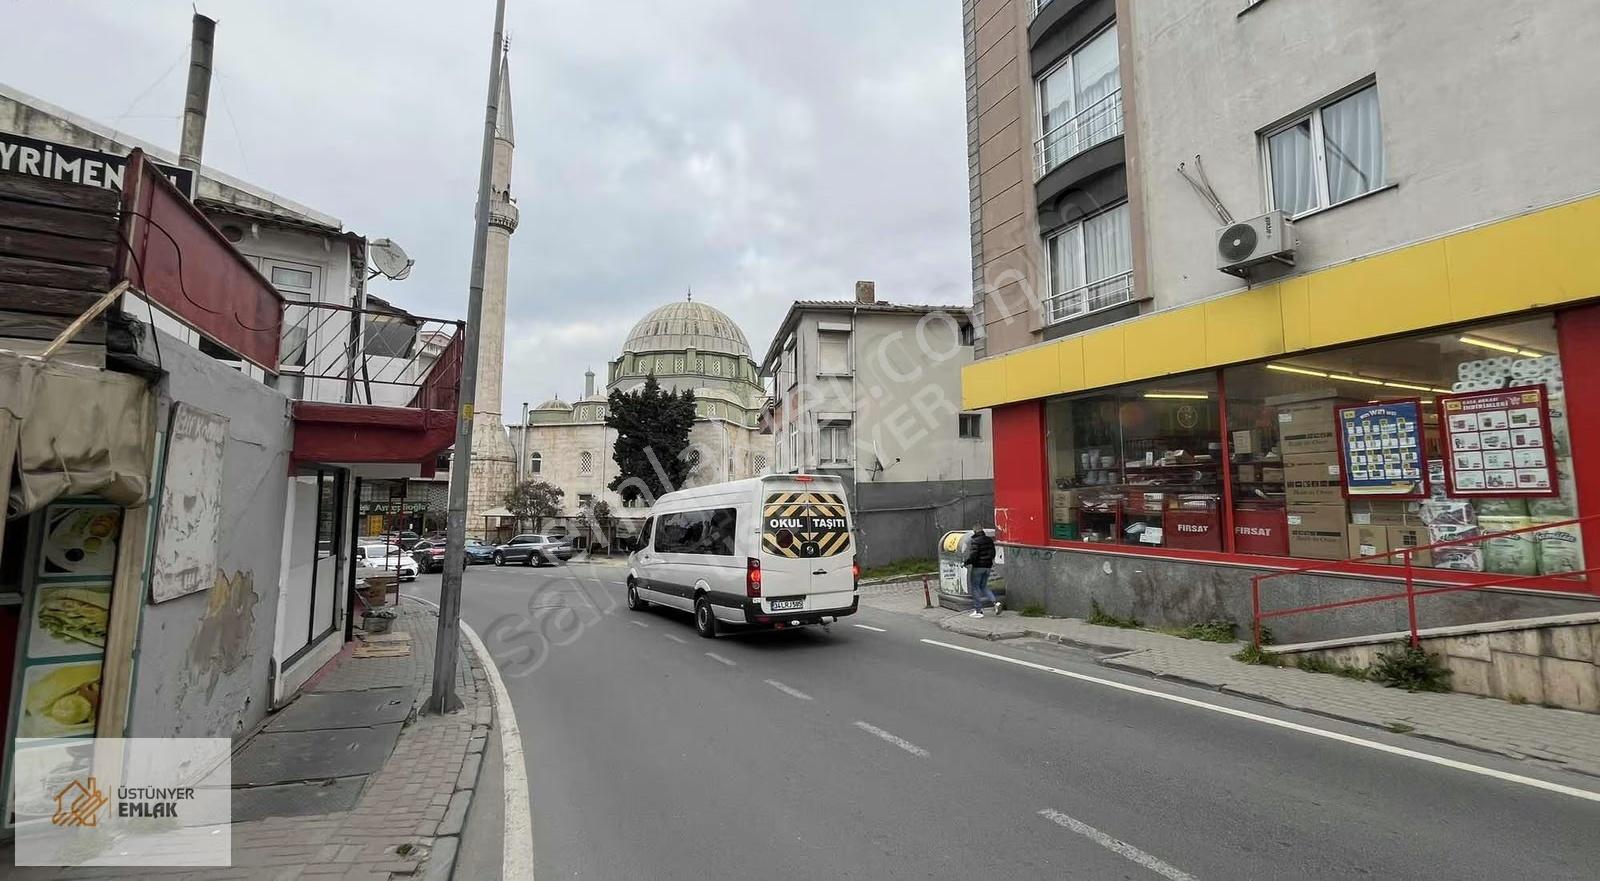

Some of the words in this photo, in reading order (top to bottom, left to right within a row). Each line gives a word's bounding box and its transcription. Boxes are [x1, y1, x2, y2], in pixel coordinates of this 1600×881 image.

[770, 519, 803, 528] OKUL
[813, 519, 844, 529] TAŞITI
[1178, 524, 1208, 533] FIRSAT
[1235, 526, 1271, 537] FIRSAT
